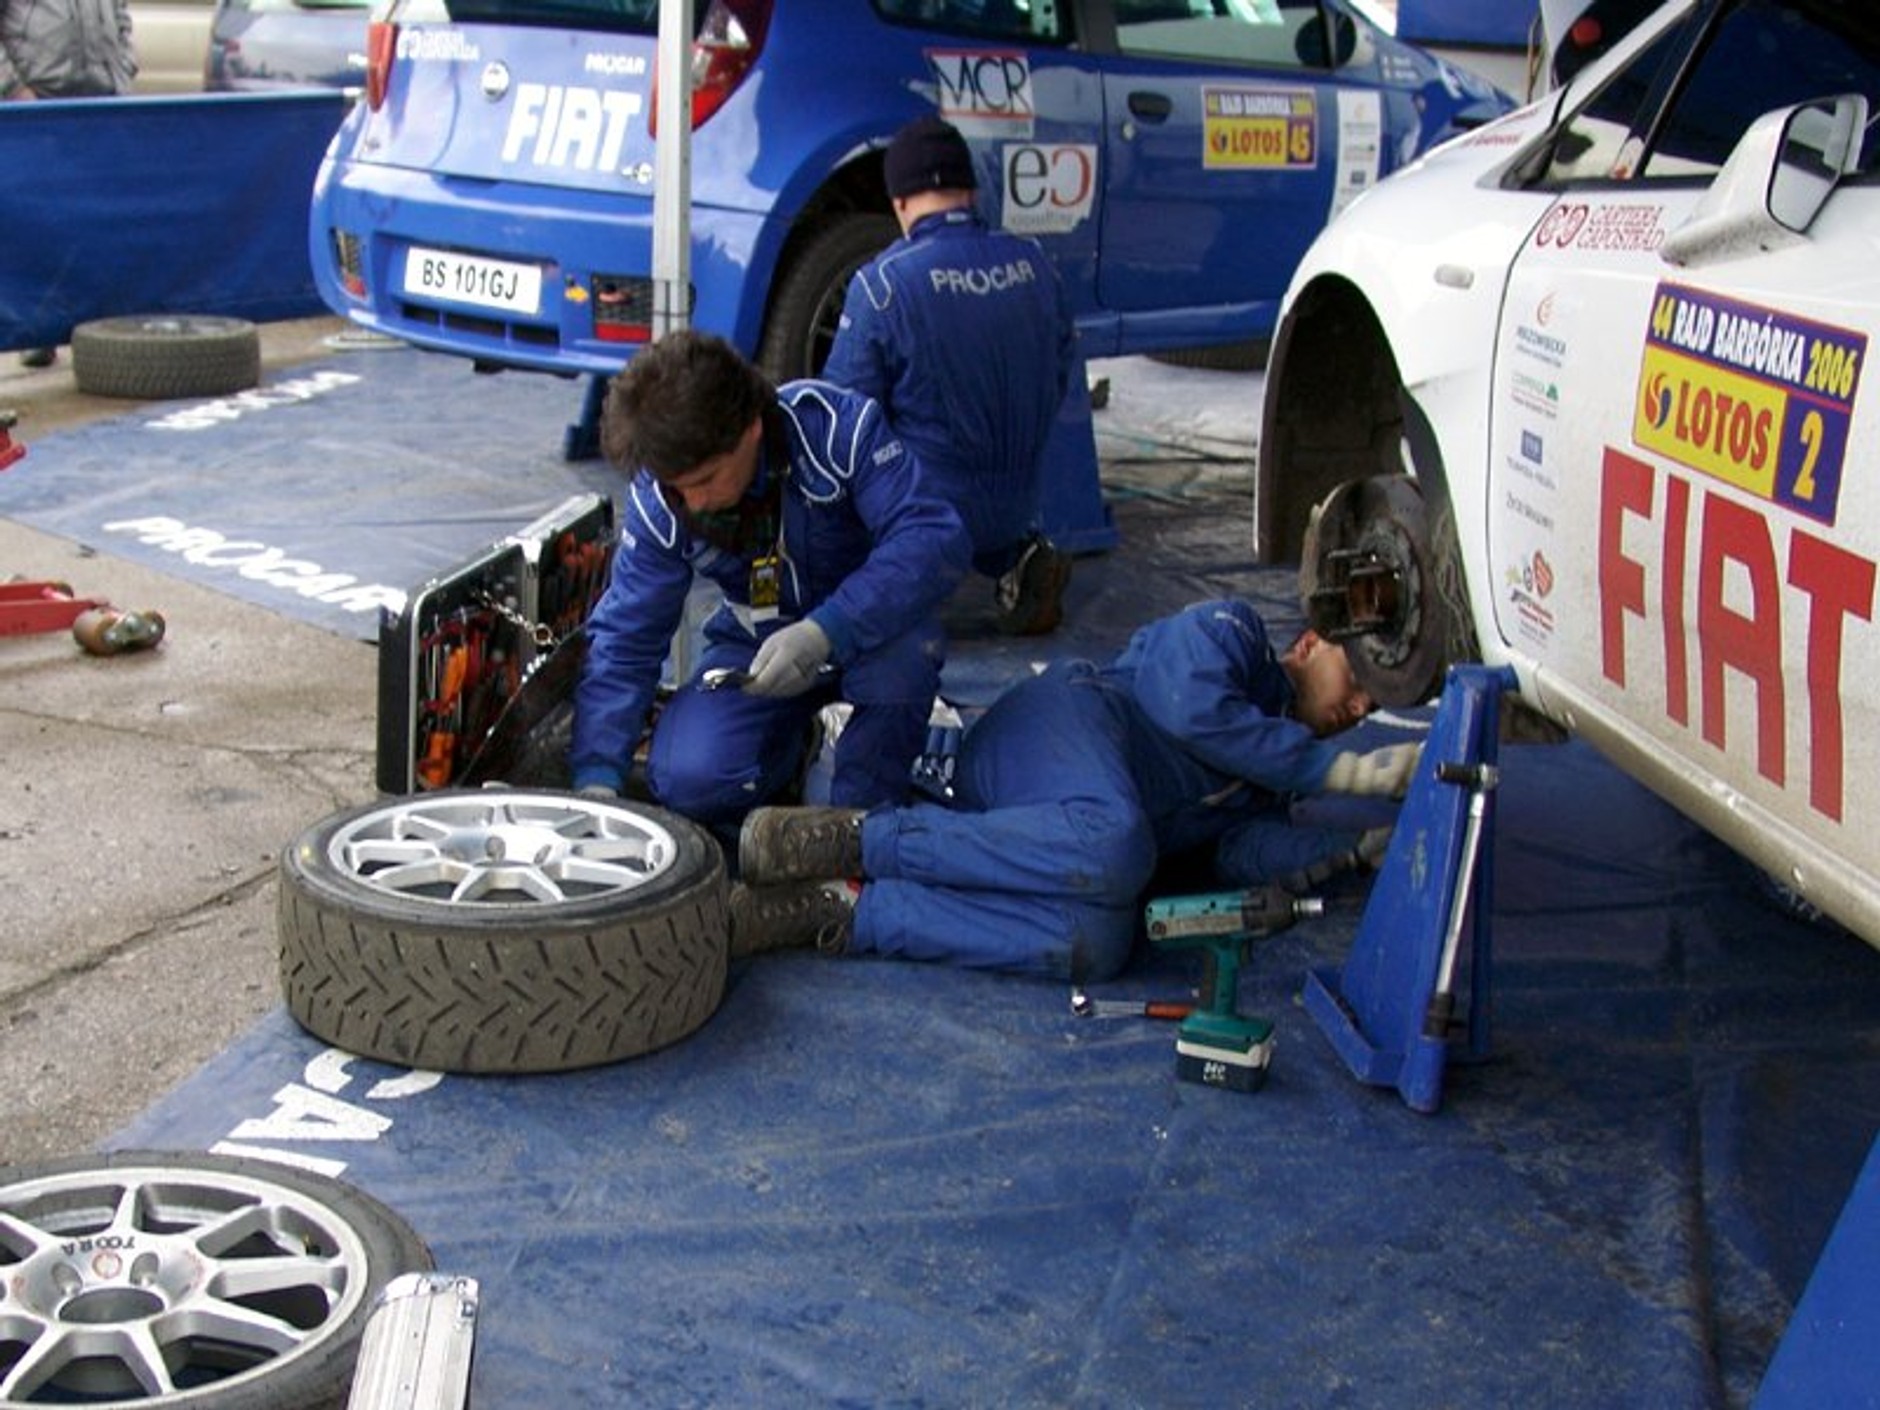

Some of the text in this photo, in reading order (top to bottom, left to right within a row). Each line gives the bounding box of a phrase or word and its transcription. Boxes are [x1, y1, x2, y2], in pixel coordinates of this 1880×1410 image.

[929, 56, 1032, 114] MCR
[501, 83, 641, 172] FIAT
[1231, 127, 1282, 155] LOTOS
[422, 258, 518, 301] BS 101GJ
[929, 260, 1036, 295] PROCAR
[1652, 295, 1675, 339] 44
[1672, 300, 1715, 352] RAJD
[1804, 339, 1859, 399] 2006
[1675, 380, 1824, 501] LOTOS 2
[1599, 445, 1877, 825] FIAT
